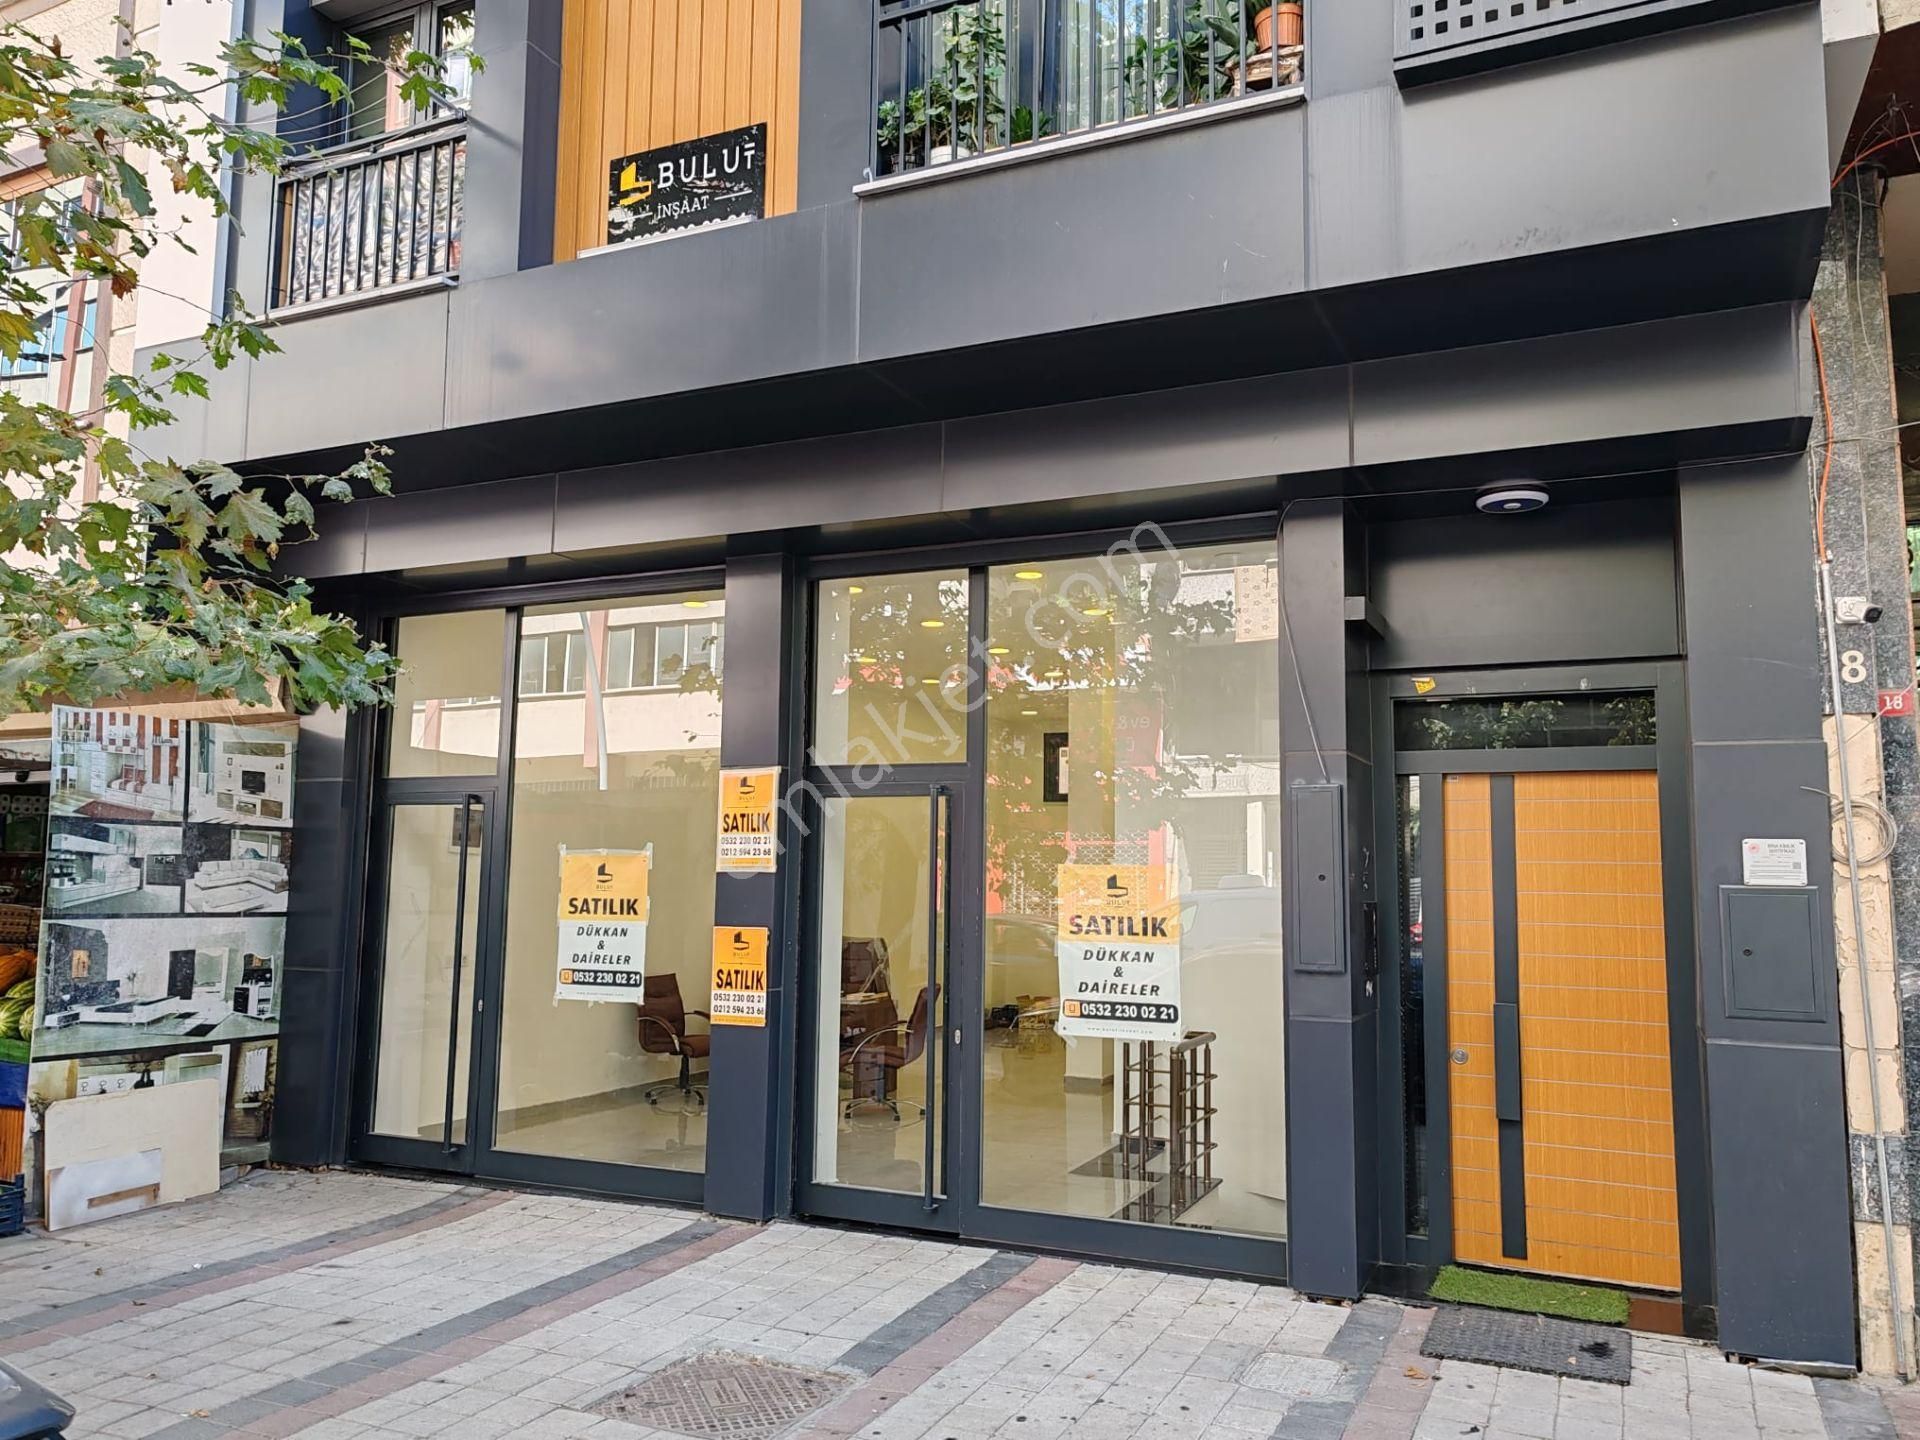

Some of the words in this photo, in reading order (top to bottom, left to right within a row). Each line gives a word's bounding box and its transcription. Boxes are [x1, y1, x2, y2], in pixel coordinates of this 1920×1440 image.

[657, 143, 756, 189] BULUT
[657, 195, 710, 219] İNŞAAT
[1841, 650, 1867, 683] 8
[1884, 696, 1903, 710] 18
[722, 813, 771, 833] SATILIK
[720, 836, 737, 845] 0532
[752, 836, 761, 845] 02
[763, 836, 771, 845] 21
[720, 848, 737, 856] 0212
[752, 848, 761, 856] 23
[568, 897, 639, 916] SATILIK
[576, 924, 629, 937] DÜKKAN
[1069, 914, 1168, 937] SATILIK
[597, 940, 605, 950] &
[572, 953, 632, 965] DAİRELER
[1083, 947, 1155, 963] DÜKKAN
[573, 971, 595, 983] 0532
[596, 972, 614, 983] 230
[615, 973, 627, 984] 02
[629, 974, 640, 985] 21
[1113, 966, 1123, 978] &
[716, 969, 764, 991] SATILIK
[1078, 979, 1161, 997] DAİRELER
[713, 993, 731, 1002] 0532
[732, 993, 745, 1002] 230
[746, 994, 755, 1003] 02
[713, 1004, 731, 1014] 0212
[732, 1005, 744, 1014] 594
[746, 1006, 755, 1015] 23
[1081, 1002, 1112, 1017] 0532
[1114, 1004, 1137, 1018] 230
[1139, 1005, 1157, 1019] 02
[1159, 1006, 1175, 1020] 21
